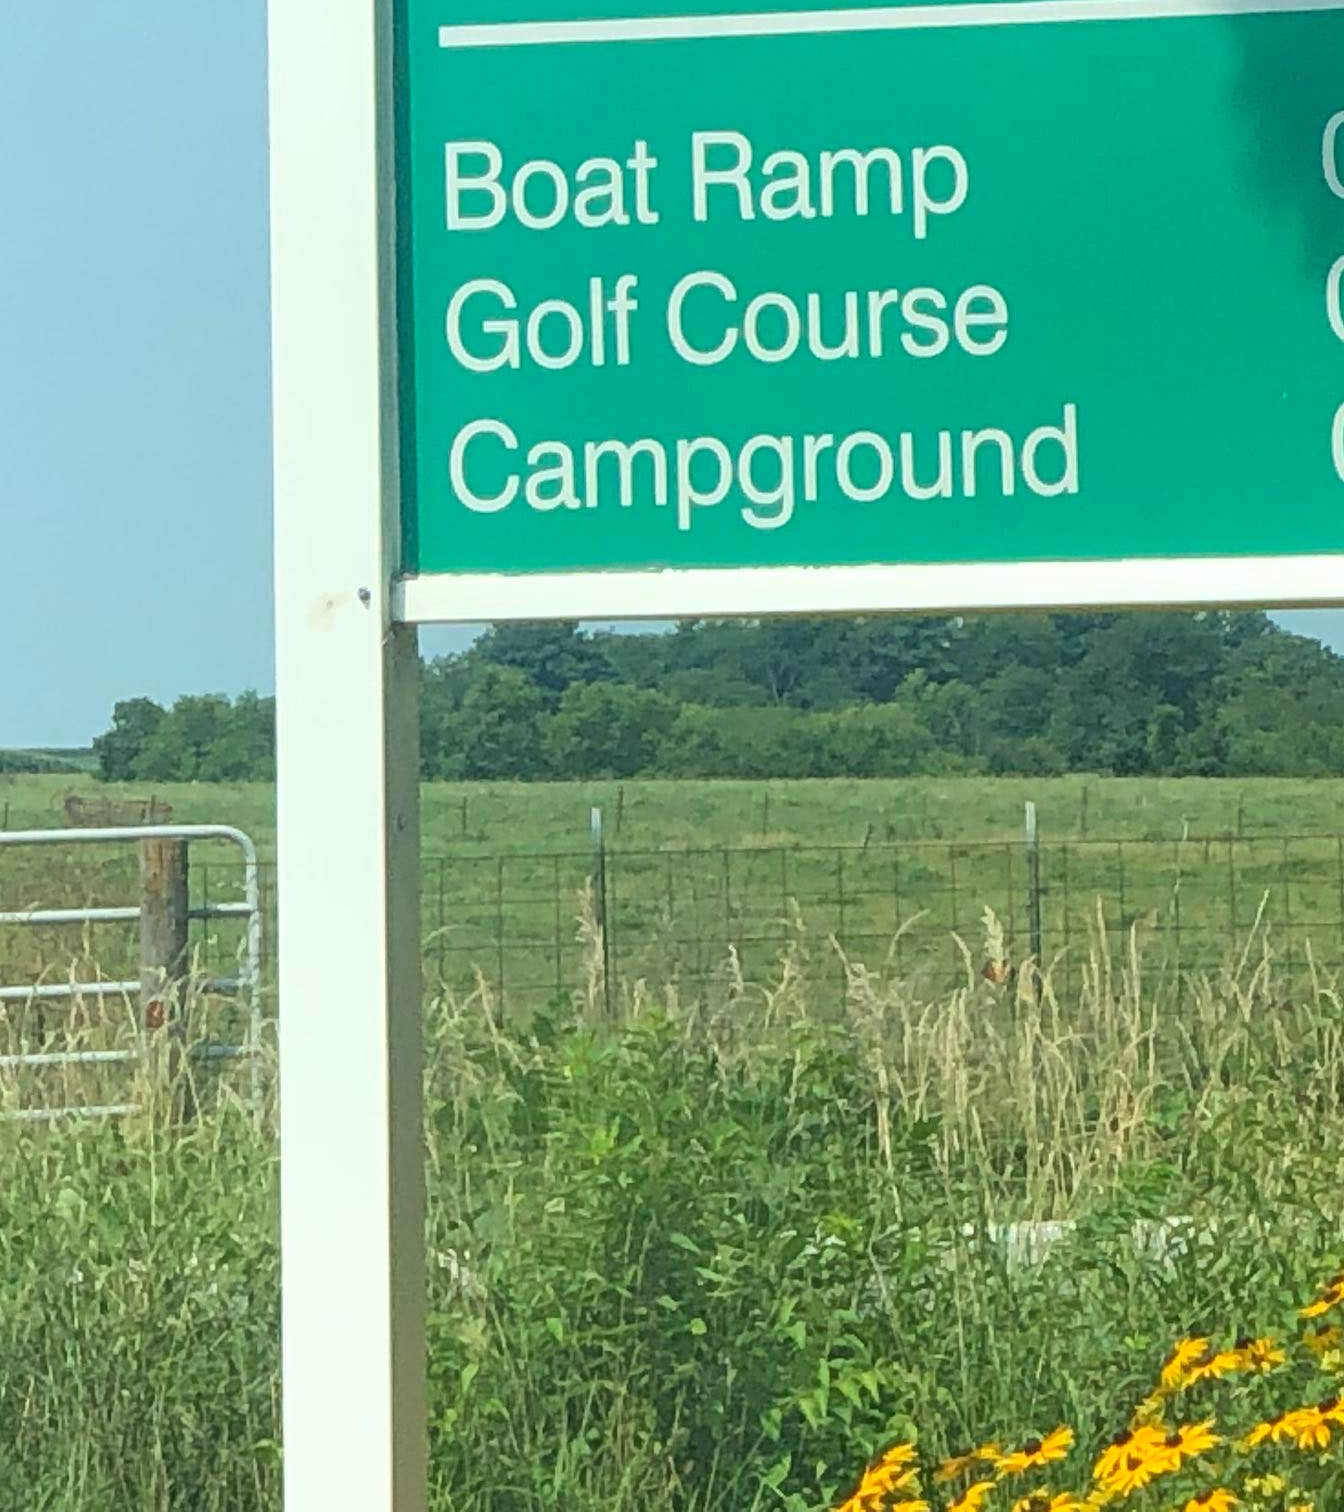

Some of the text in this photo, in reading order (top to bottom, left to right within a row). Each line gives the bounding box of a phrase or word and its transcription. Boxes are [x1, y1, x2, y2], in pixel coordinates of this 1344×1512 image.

[444, 139, 660, 231] Boat
[691, 130, 969, 240] Ramp
[445, 273, 639, 373] Golf
[666, 269, 1009, 366] Course
[448, 402, 1079, 531] Campground
